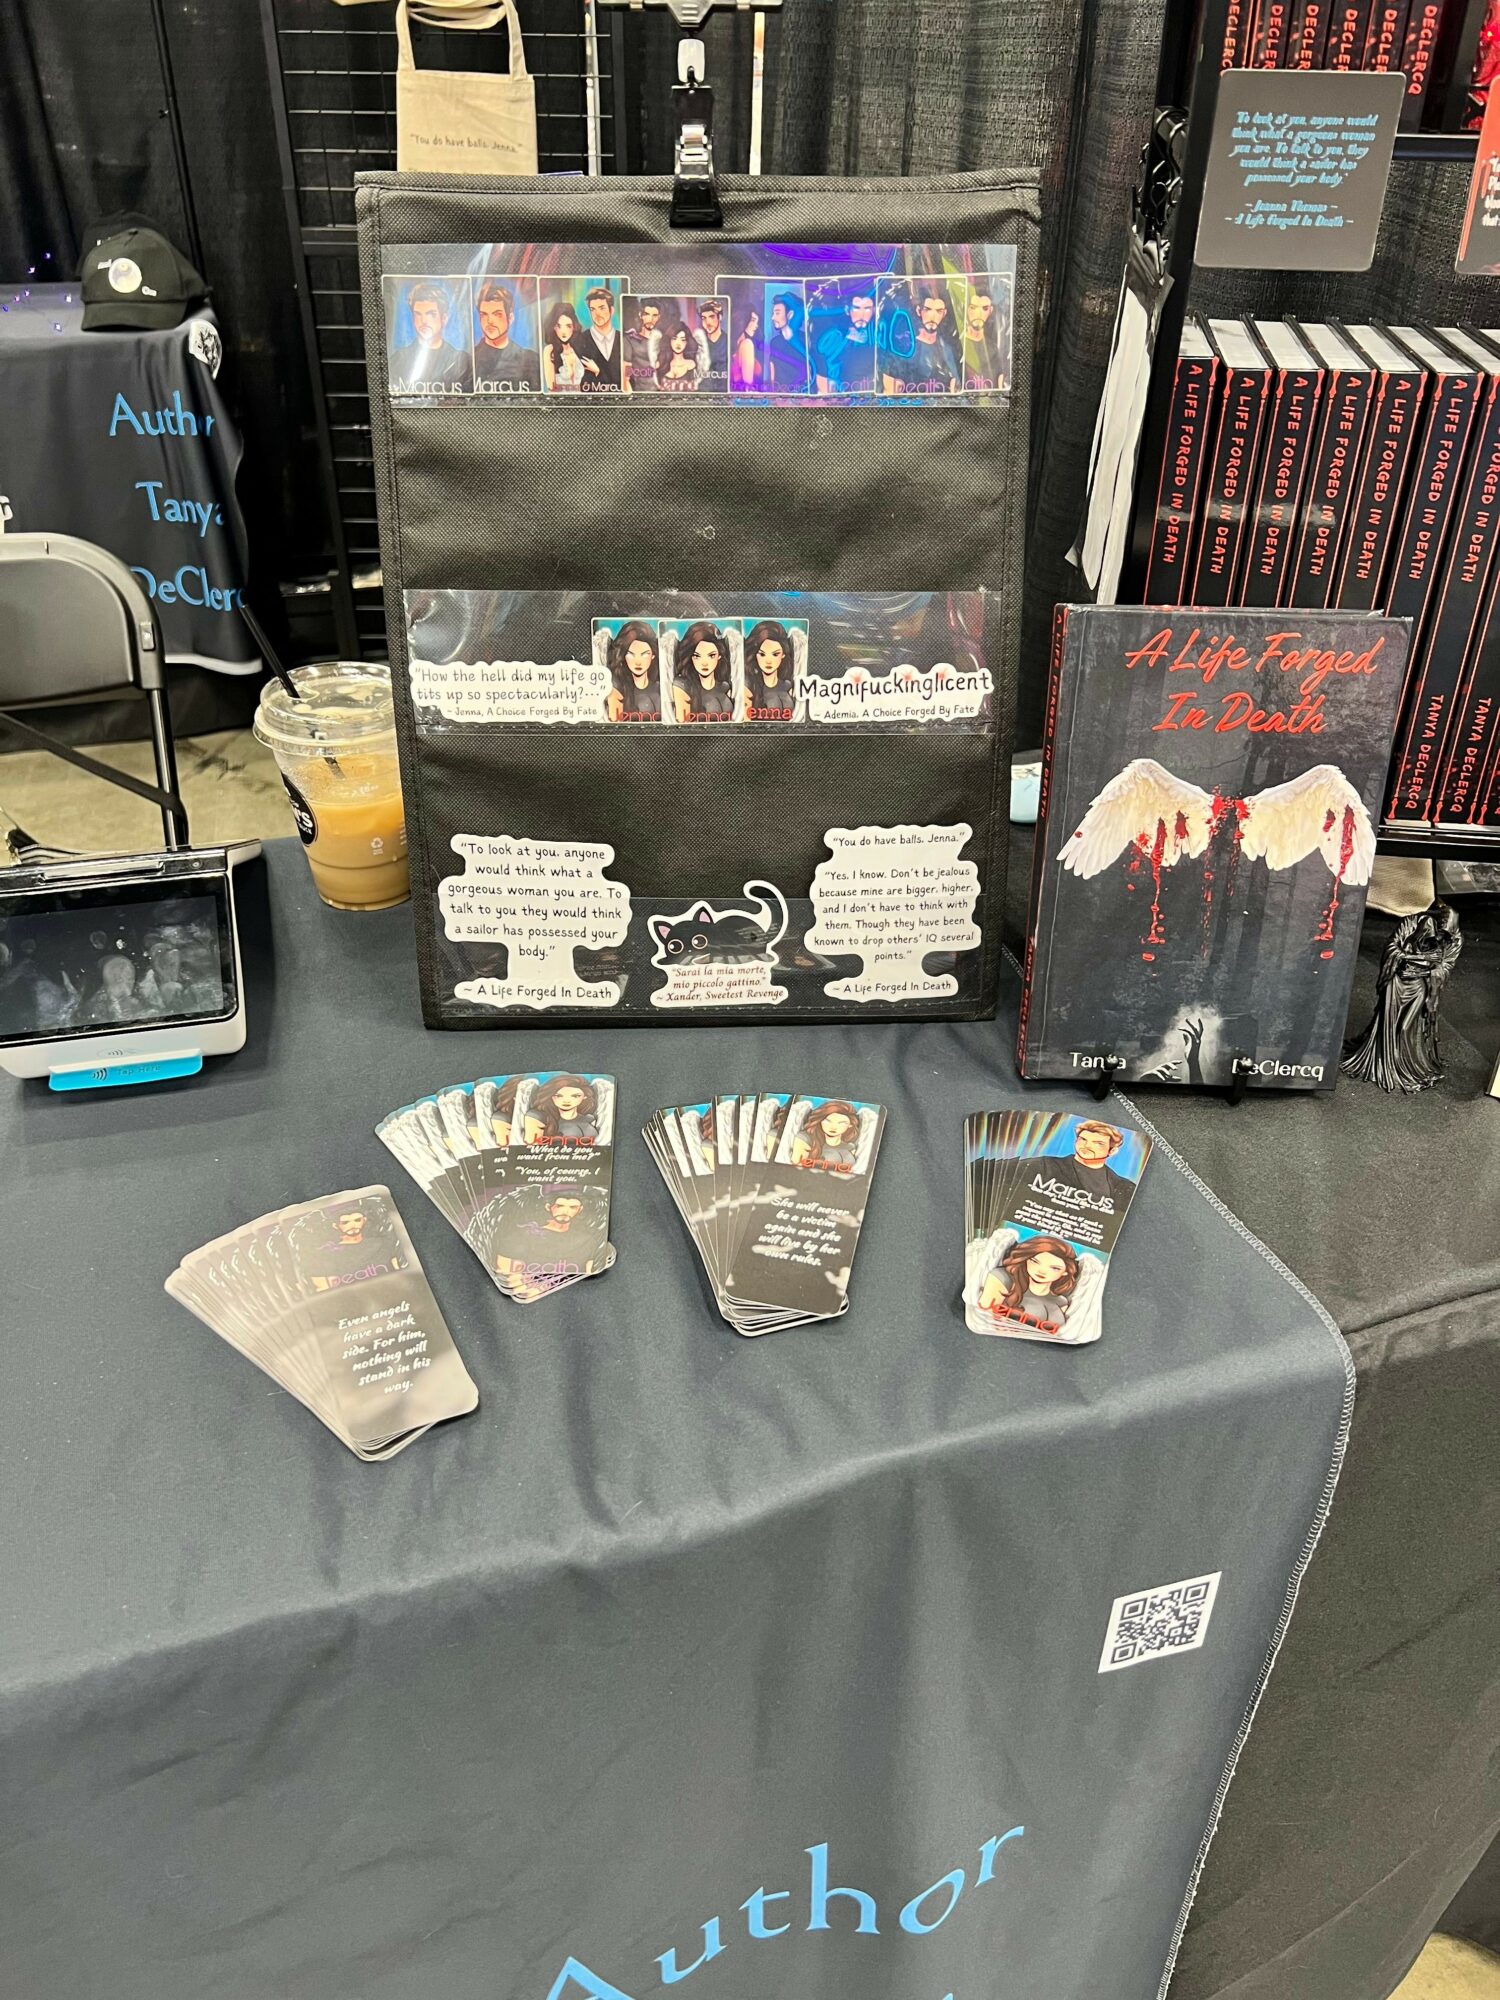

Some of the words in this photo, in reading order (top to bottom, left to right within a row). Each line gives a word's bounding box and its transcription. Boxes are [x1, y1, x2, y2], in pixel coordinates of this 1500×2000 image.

[1263, 5, 1284, 70] DECLER
[1408, 5, 1438, 95] DECLERCQ
[1188, 364, 1203, 375] A
[1452, 378, 1468, 390] A
[1184, 383, 1200, 419] LIFE
[109, 390, 215, 436] Authr
[1444, 397, 1463, 433] LIFE
[1174, 425, 1194, 487] FORGED
[1428, 439, 1453, 502] FORGED
[1172, 492, 1184, 509] IN
[1422, 507, 1437, 525] IN
[1163, 515, 1180, 564] DEATH
[1408, 530, 1432, 580] DEATH
[1125, 628, 1173, 671] A
[1167, 629, 1252, 684] Life
[1255, 632, 1387, 696] Forged
[453, 669, 476, 682] the
[481, 669, 506, 682] hell
[511, 669, 532, 683] did
[538, 672, 556, 685] my
[560, 667, 585, 685] life
[590, 671, 605, 685] go
[417, 688, 441, 700] tits
[446, 690, 463, 704] up
[467, 691, 481, 700] so
[799, 671, 991, 704] Magnifuckinglicent
[486, 707, 493, 716] A
[496, 706, 526, 716] Choice
[529, 706, 560, 719] Forged
[563, 706, 574, 718] By
[577, 706, 598, 716] Fate
[862, 709, 870, 718] A
[872, 707, 902, 718] Choice
[905, 706, 936, 718] Forged
[939, 705, 951, 717] By
[954, 705, 975, 714] Fate
[1152, 691, 1214, 733] In
[1214, 691, 1329, 734] Death
[1422, 694, 1444, 739] TANYA
[1468, 697, 1492, 742] TANYA
[1405, 744, 1431, 809] DECLERCQ
[1450, 747, 1478, 812] DECLERCQ
[859, 835, 871, 846] do
[874, 835, 896, 845] have
[488, 844, 512, 855] look
[516, 846, 530, 856] at
[564, 848, 605, 862] anyone
[475, 864, 510, 876] would
[515, 865, 546, 876] think
[550, 866, 582, 878] what
[586, 870, 593, 878] a
[890, 868, 919, 879] Don't
[923, 867, 934, 877] be
[935, 866, 970, 880] jealous
[448, 884, 502, 898] gorgeous
[507, 888, 549, 897] woman
[554, 888, 575, 901] you
[606, 888, 622, 899] To
[819, 887, 858, 898] because
[860, 887, 885, 897] mine
[886, 888, 903, 896] are
[855, 919, 890, 931] Though
[894, 918, 915, 931] they
[918, 916, 940, 927] have
[943, 916, 965, 926] been
[455, 926, 462, 934] a
[466, 924, 499, 936] sailor
[503, 924, 524, 936] has
[528, 927, 587, 940] possessed
[591, 930, 619, 942] your
[814, 936, 844, 946] known
[848, 936, 859, 945] to
[862, 935, 884, 948] drop
[926, 933, 937, 943] IQ
[941, 932, 974, 942] several
[704, 966, 713, 976] la
[716, 967, 734, 975] mia
[477, 985, 487, 996] A
[491, 985, 512, 999] Life
[517, 985, 557, 1000] Forged
[561, 985, 572, 997] In
[576, 987, 612, 999] Death
[673, 980, 690, 989] mio
[689, 978, 724, 994] piccolo
[705, 990, 743, 1000] Sweetest
[746, 989, 784, 1001] Revenge
[1070, 1052, 1126, 1070] Tana
[1032, 1173, 1114, 1209] Marcus
[328, 1263, 388, 1289] Death
[338, 1316, 369, 1330] Even
[371, 1300, 410, 1320] angels
[977, 1297, 1061, 1335] Jenna
[343, 1329, 372, 1343] have
[375, 1326, 383, 1334] a
[386, 1314, 416, 1331] dark
[373, 1337, 395, 1350] For
[352, 1350, 402, 1372] nothing
[404, 1339, 428, 1356] will
[358, 1366, 394, 1386] stand
[397, 1364, 410, 1374] in
[413, 1357, 431, 1370] his
[384, 1380, 413, 1394] way.
